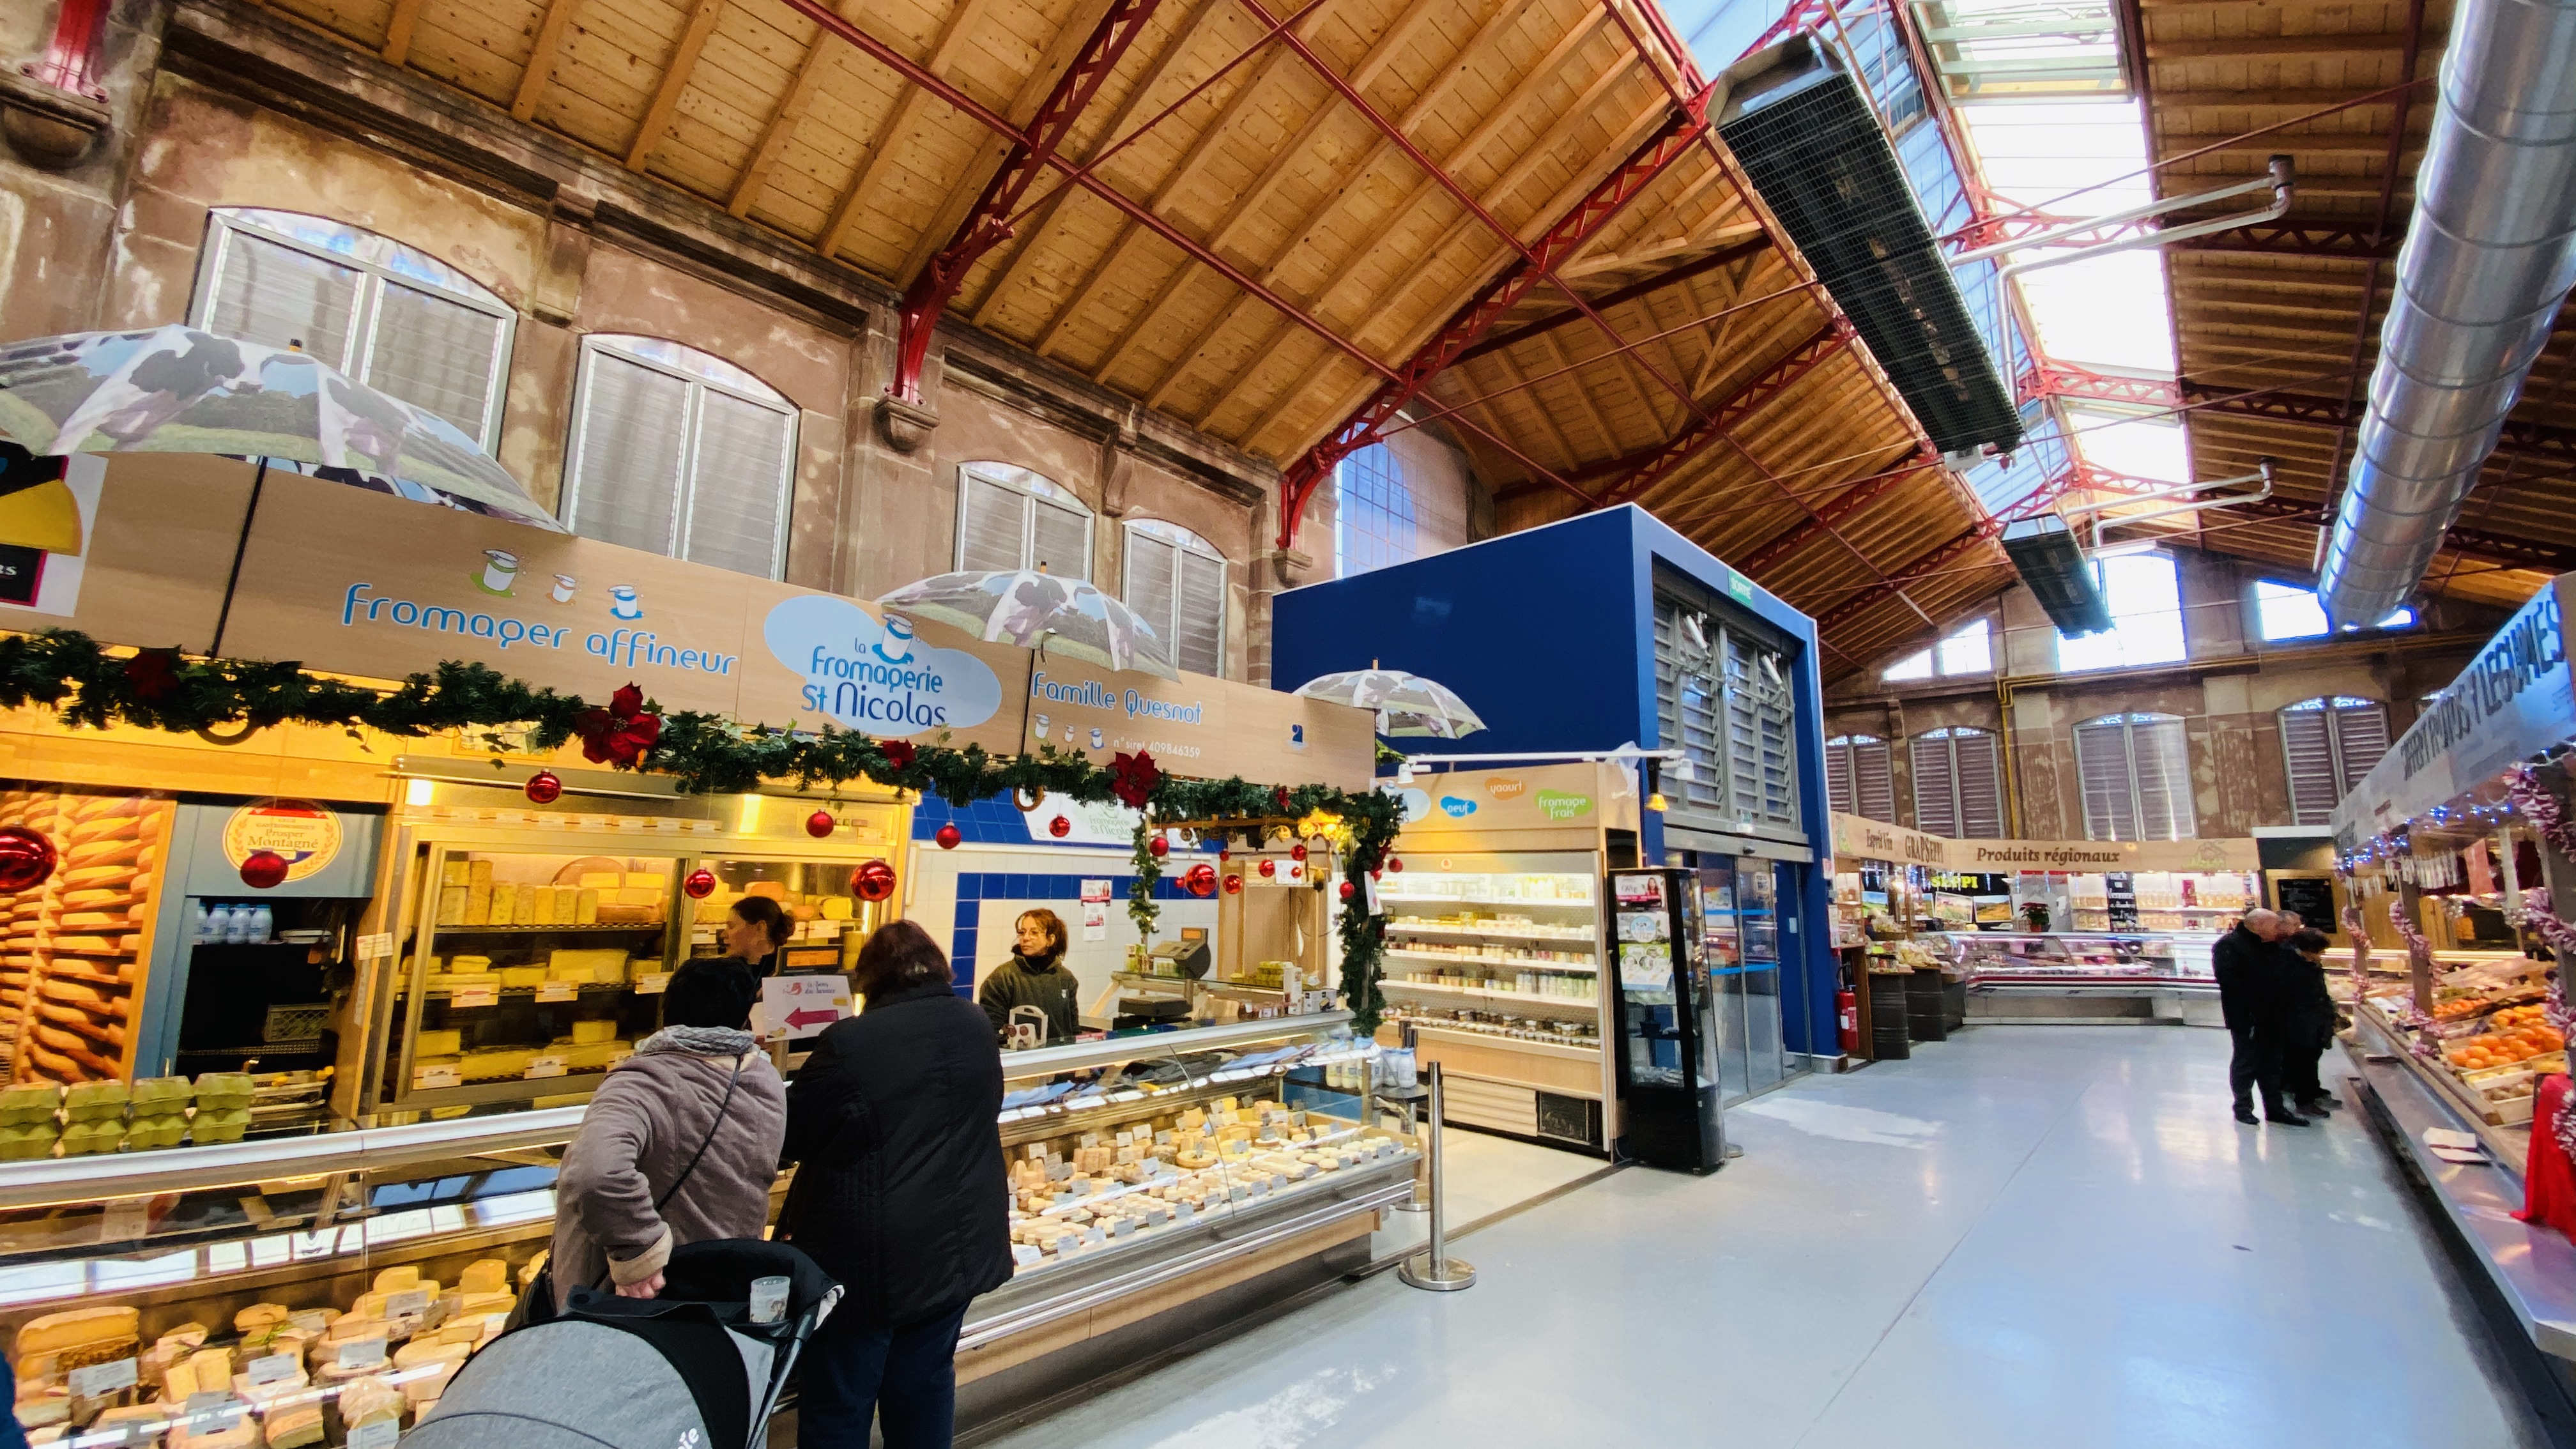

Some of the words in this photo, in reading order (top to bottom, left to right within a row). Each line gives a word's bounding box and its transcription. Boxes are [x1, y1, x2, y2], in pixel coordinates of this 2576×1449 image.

[1731, 577, 1752, 600] SORTIE
[342, 583, 571, 648] fromager
[586, 629, 737, 675] affineur
[854, 636, 866, 654] la
[801, 684, 827, 713] St
[835, 682, 946, 728] Nicolas
[1124, 688, 1202, 726] Quesnot
[1148, 740, 1201, 758] 409846359
[1490, 780, 1522, 794] yaourt
[1447, 801, 1470, 816] oeuf
[1549, 806, 1575, 821] frais
[266, 829, 305, 839] Prosper
[1100, 824, 1133, 836] Nicola
[247, 836, 319, 850] Montagné
[1977, 847, 2040, 862] Produits
[2044, 847, 2120, 866] régionaux
